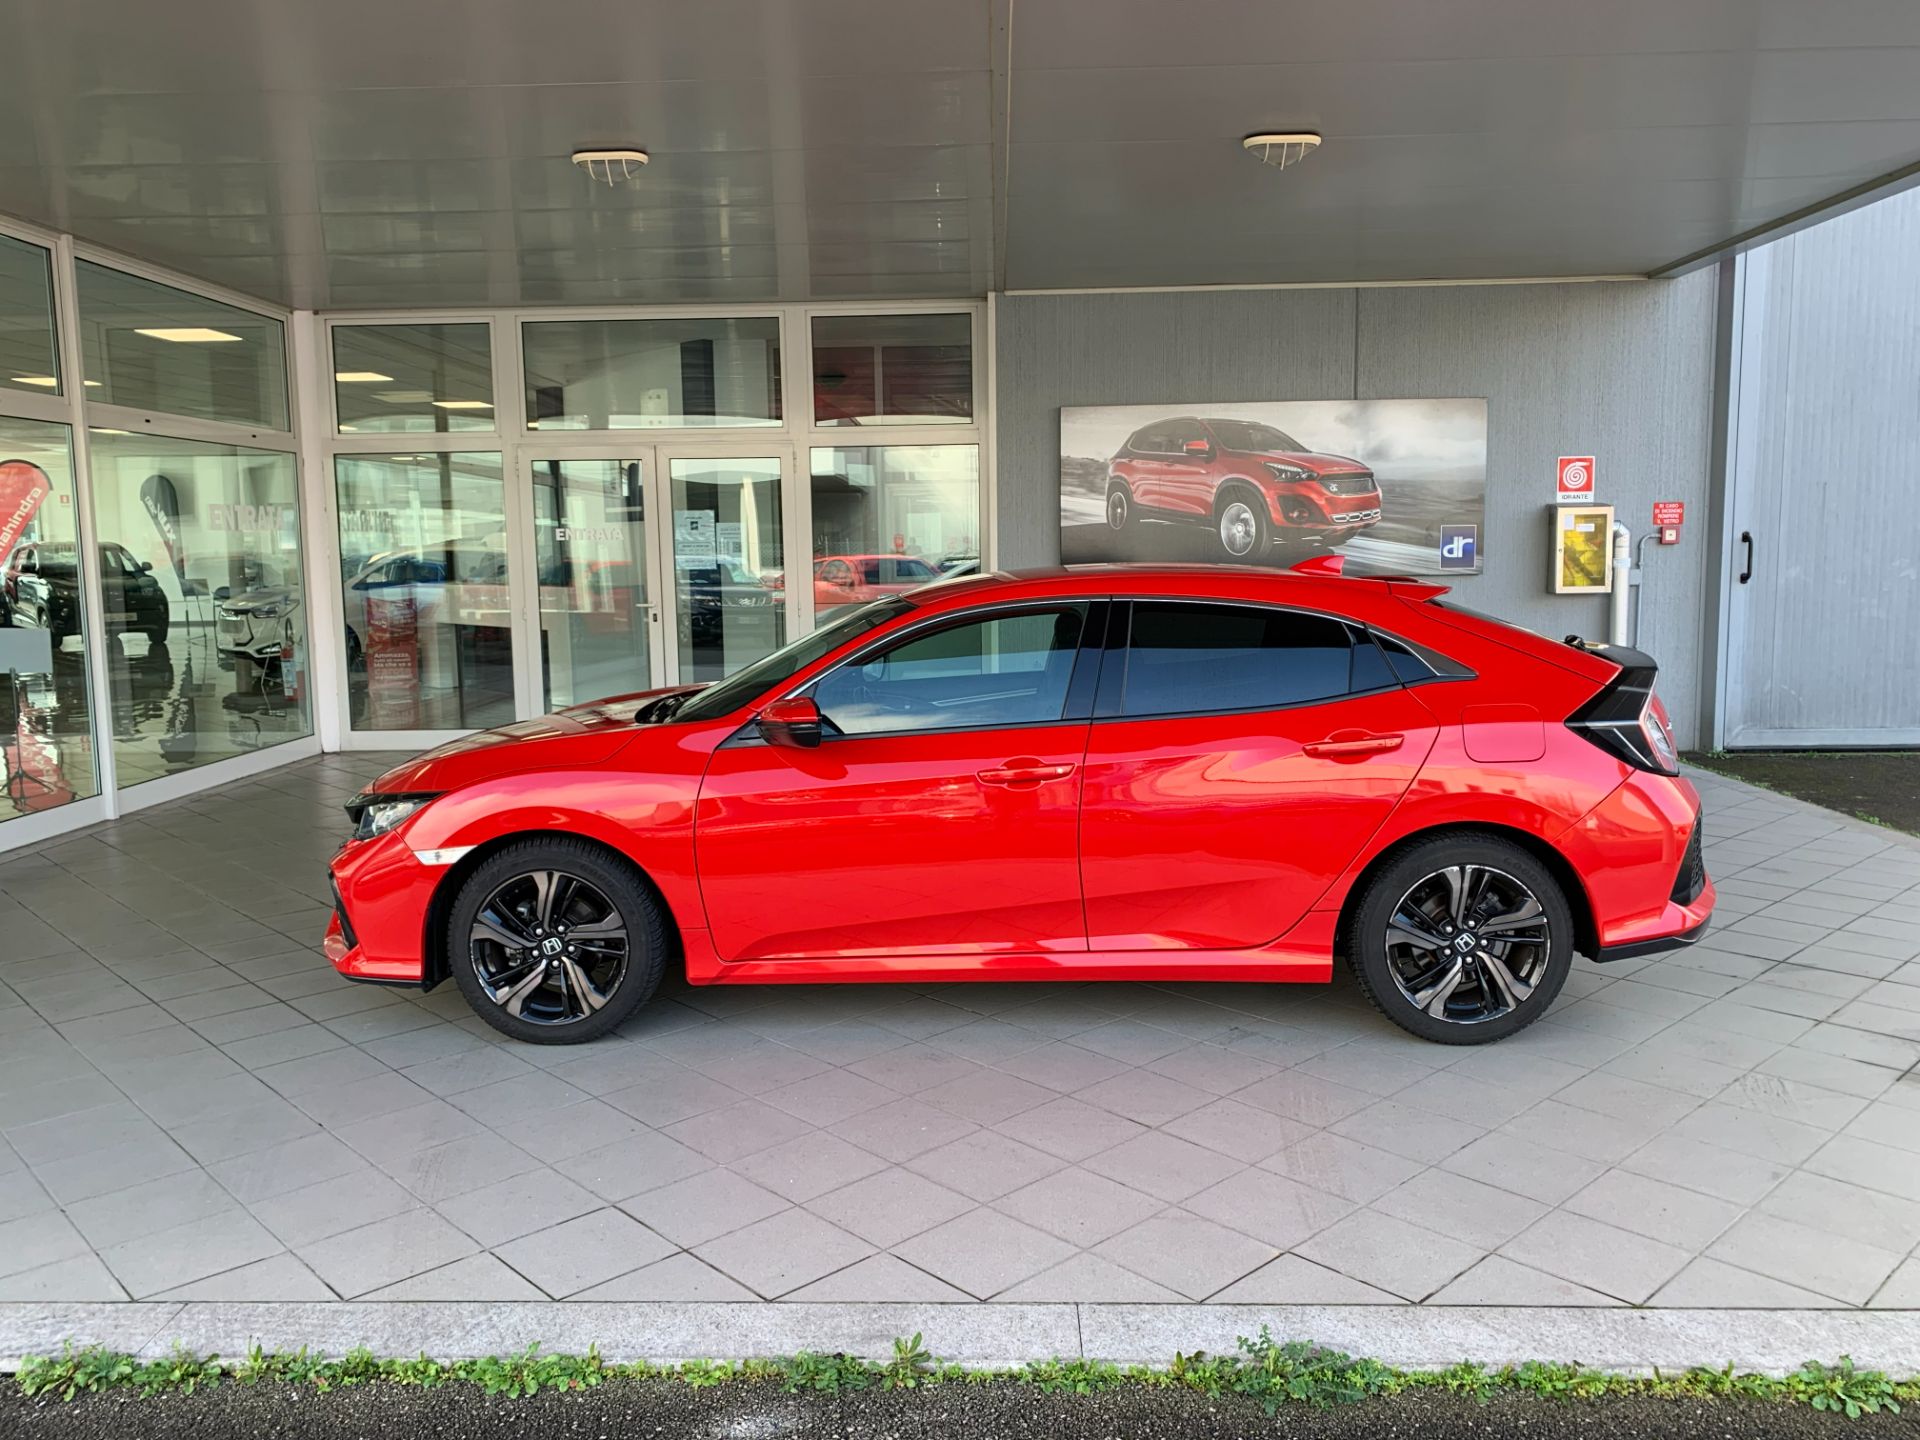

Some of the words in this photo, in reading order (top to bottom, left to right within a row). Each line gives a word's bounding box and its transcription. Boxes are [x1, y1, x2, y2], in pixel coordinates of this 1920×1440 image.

[0, 487, 42, 553] ahindra
[208, 503, 283, 531] ENTRATA
[555, 527, 624, 541] ENTRATA
[1442, 536, 1474, 558] dr
